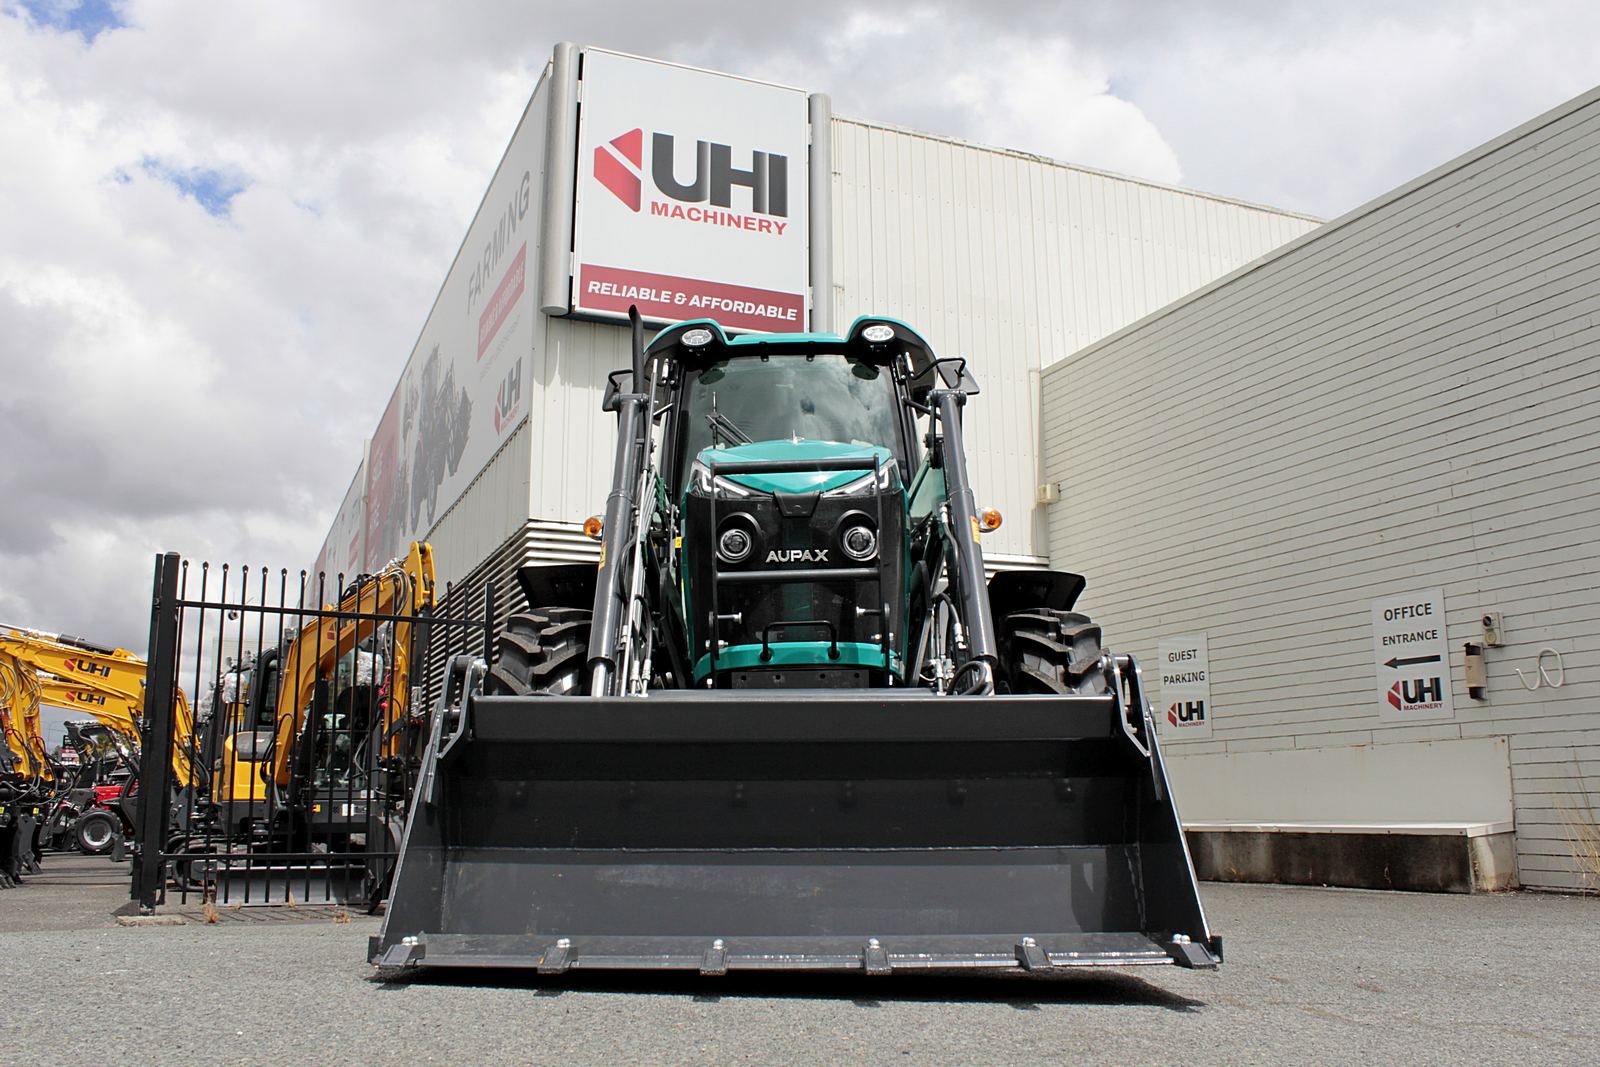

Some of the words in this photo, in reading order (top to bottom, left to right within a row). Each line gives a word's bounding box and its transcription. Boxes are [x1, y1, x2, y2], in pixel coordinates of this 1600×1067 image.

[652, 132, 788, 218] UHI
[651, 201, 787, 235] MACHINERY
[467, 170, 530, 315] FARMING
[588, 280, 672, 304] RELIABLE
[674, 293, 687, 305] &
[689, 294, 798, 321] AFFORDABLE
[765, 549, 829, 563] AUPAX
[1384, 603, 1432, 621] OFFICE
[1382, 630, 1438, 646] ENTRANCE
[1168, 649, 1198, 662] GUEST
[77, 659, 111, 678] UHI
[1163, 671, 1205, 685] PARKING
[77, 691, 106, 706] UHI
[1402, 677, 1442, 704] UHI
[1178, 700, 1205, 721] UHI
[1403, 703, 1443, 711] MACHINERY
